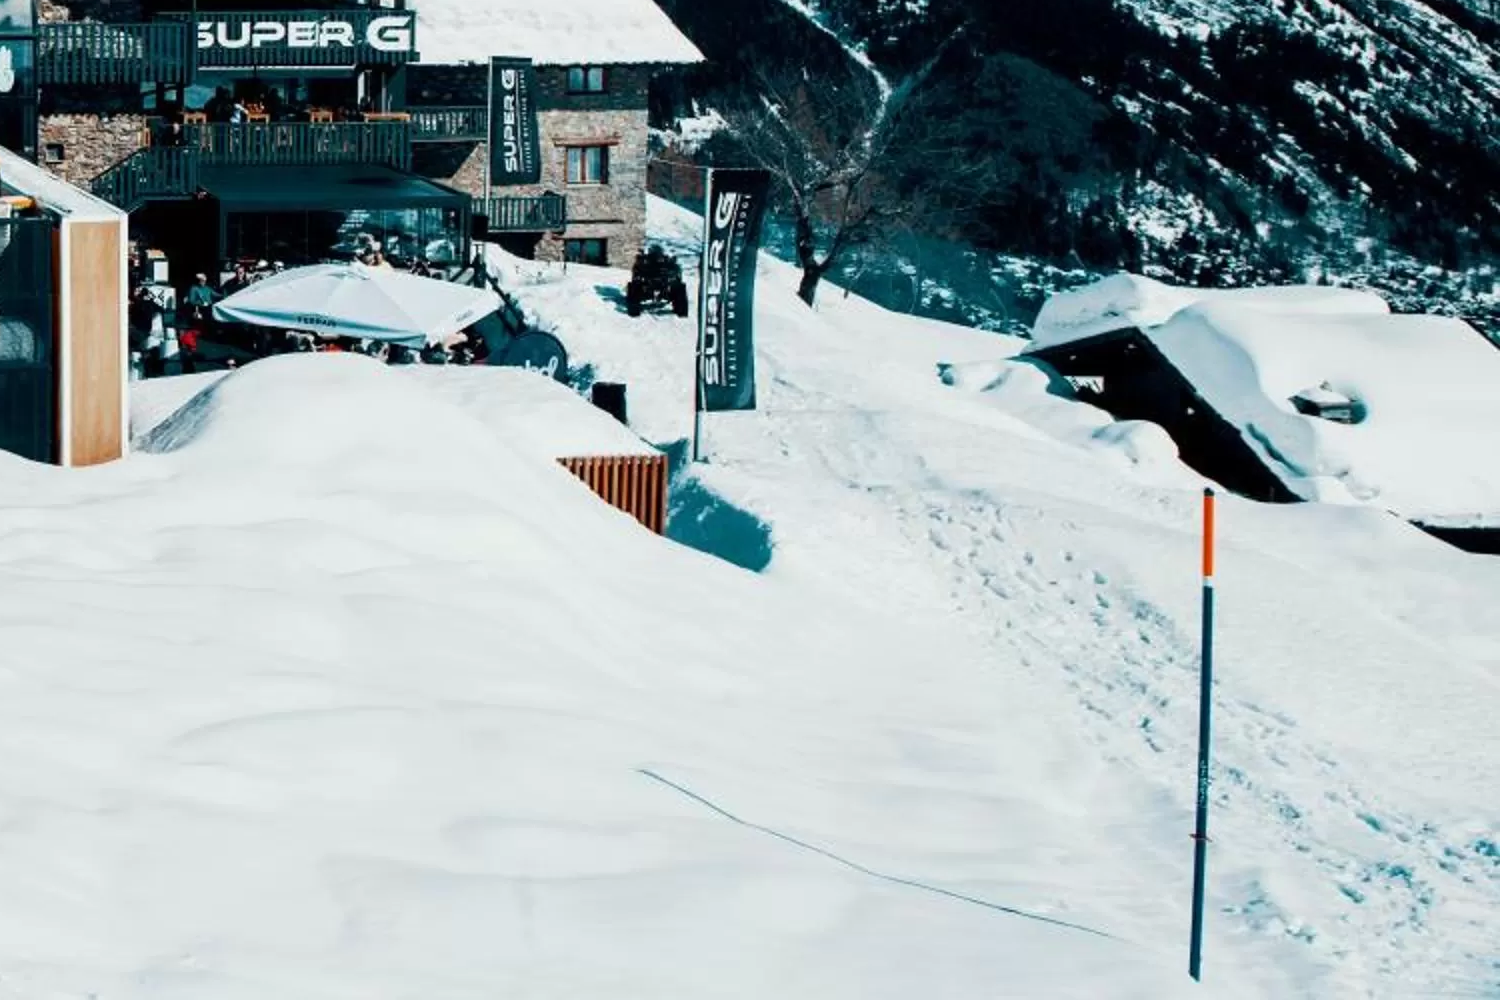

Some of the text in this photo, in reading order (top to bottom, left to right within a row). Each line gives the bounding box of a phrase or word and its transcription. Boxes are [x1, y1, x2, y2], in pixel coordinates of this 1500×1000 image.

[197, 15, 411, 52] SUPER G
[501, 69, 519, 174] SUPER G
[705, 192, 737, 386] SUPER G
